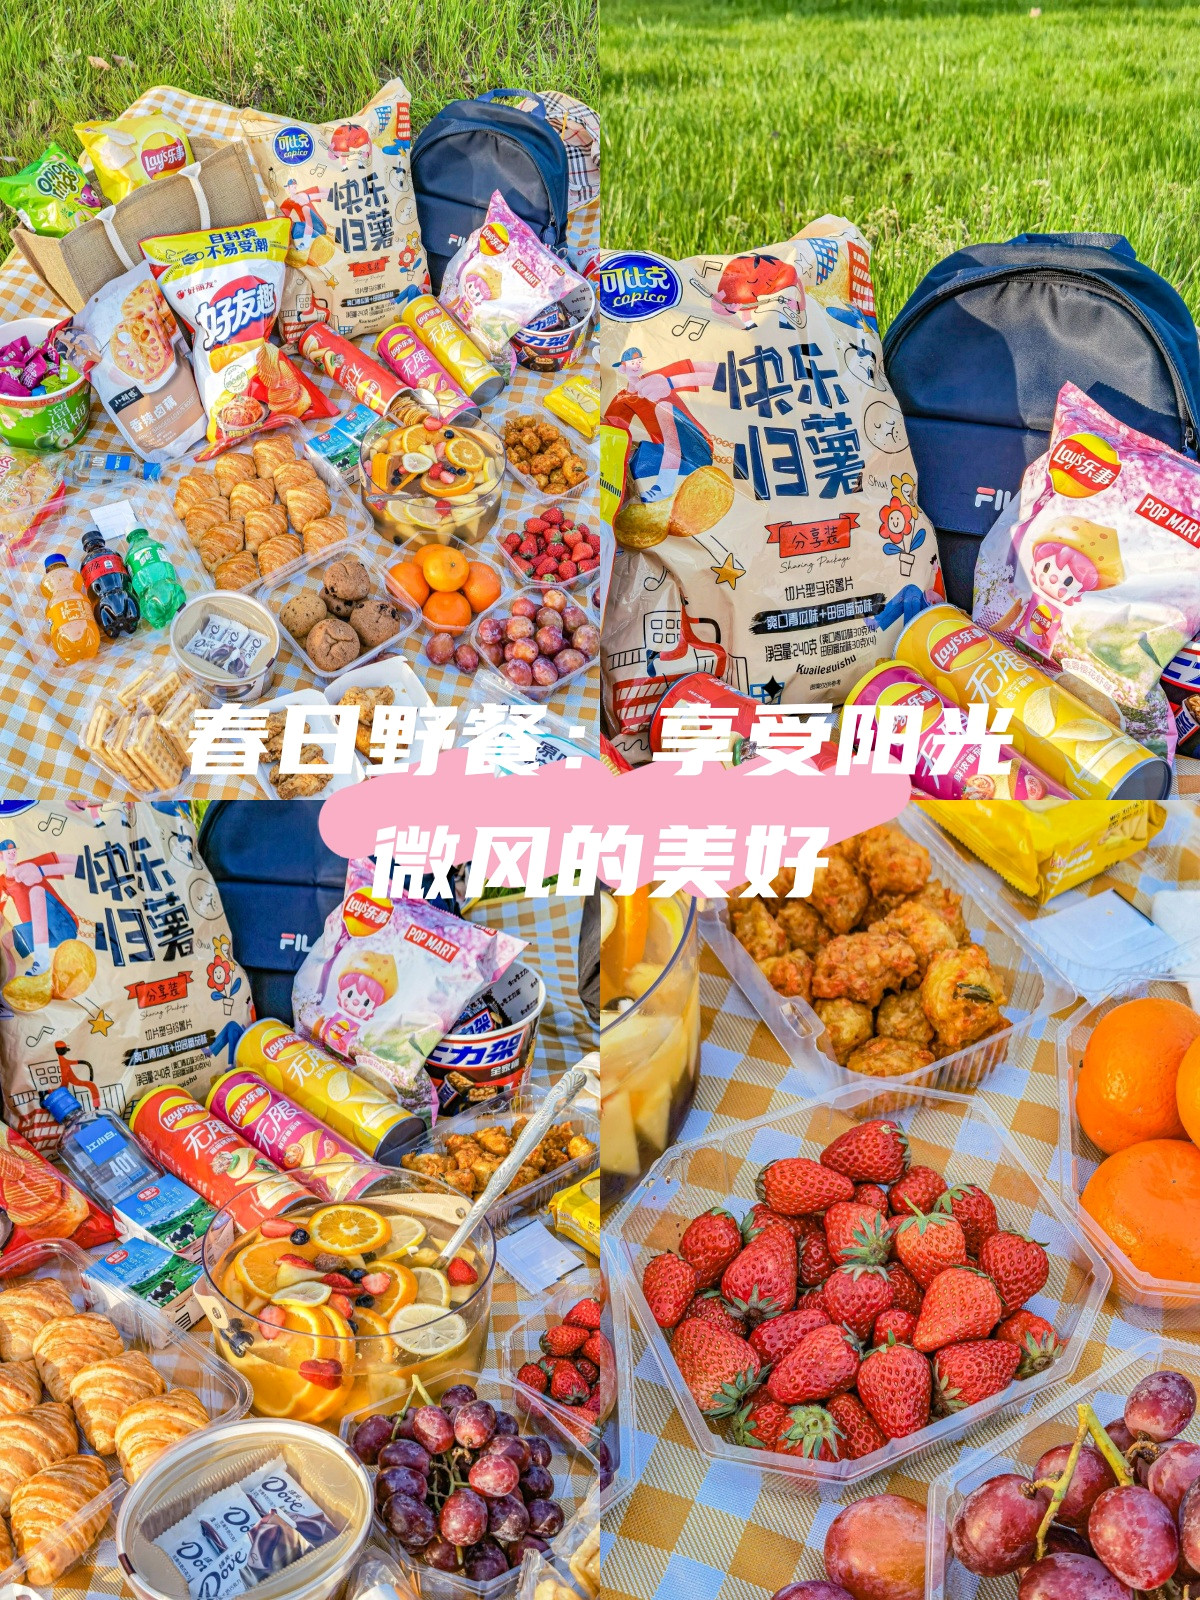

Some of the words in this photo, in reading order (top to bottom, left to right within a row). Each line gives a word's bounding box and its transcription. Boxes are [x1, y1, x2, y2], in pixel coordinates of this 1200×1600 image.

[277, 133, 309, 151] 可比克
[36, 161, 71, 194] Onion
[52, 169, 78, 201] rings
[327, 172, 390, 215] 快乐
[208, 228, 258, 245] 自封袋
[335, 208, 394, 253] 归薯
[205, 238, 269, 260] 不易受潮
[601, 265, 671, 293] 可比克
[612, 290, 668, 308] copico
[196, 283, 276, 350] 好友趣
[712, 342, 850, 419] 快乐
[733, 411, 866, 501] 归薯
[1053, 444, 1116, 485] Lay's乐事
[1140, 497, 1170, 521] POP
[791, 526, 841, 550] 分享装
[779, 560, 815, 575] Sharing
[816, 554, 851, 569] Package
[785, 576, 854, 601] 切片型马铃薯片
[766, 599, 873, 630] 爽口青瓜味+田园番茄味
[934, 628, 985, 667] Lay's乐事
[796, 654, 857, 675] Kuaileguishu
[74, 837, 176, 902] 快乐
[345, 895, 391, 925] Lay's乐事
[95, 891, 195, 967] 归薯
[406, 926, 427, 946] POP
[424, 934, 458, 962] MART
[146, 981, 180, 1002] 分享装
[85, 1131, 115, 1153] 江小白
[254, 1099, 303, 1157] 无限
[109, 1152, 138, 1177] 401
[261, 1476, 304, 1513] Dove
[223, 1505, 250, 1533] Do
[197, 1549, 247, 1600] Dove
